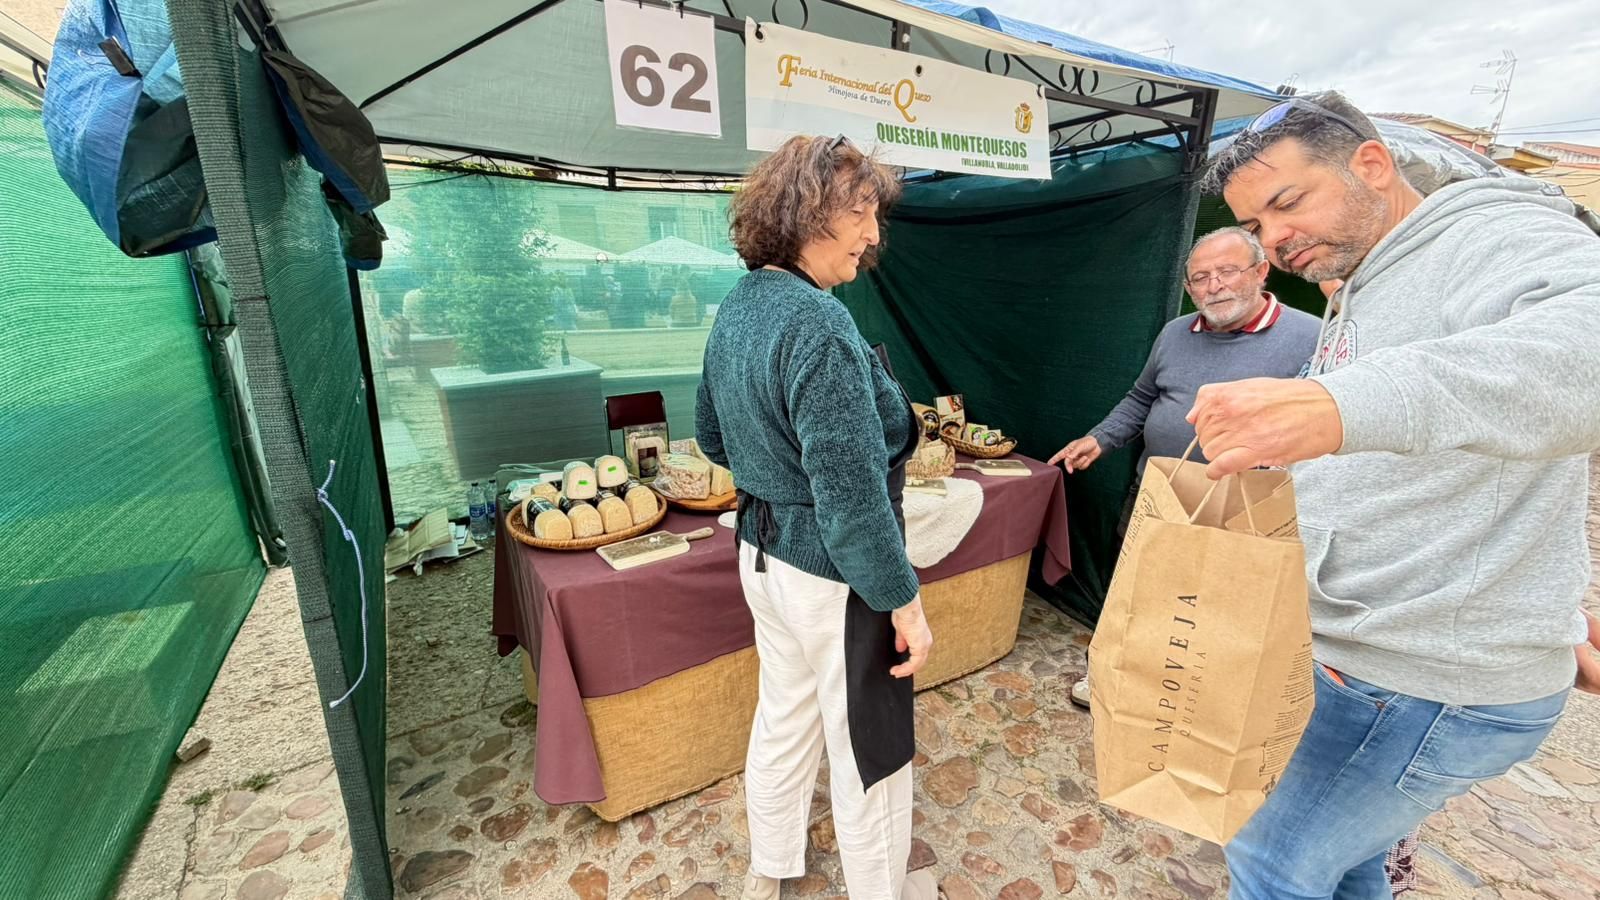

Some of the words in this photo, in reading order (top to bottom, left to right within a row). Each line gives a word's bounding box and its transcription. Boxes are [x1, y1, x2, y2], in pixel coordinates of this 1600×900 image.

[620, 44, 712, 114] 62
[777, 54, 818, 87] Feria
[819, 69, 879, 94] Internacional
[878, 82, 896, 96] del
[894, 79, 932, 123] Queso
[828, 85, 859, 100] Hinojosa
[860, 92, 868, 102] de
[869, 96, 892, 106] Duero
[876, 122, 939, 149] QUESERÍA
[941, 132, 1028, 158] MONTEQUESOS
[1147, 593, 1198, 772] CAMPOVEJA
[1179, 651, 1207, 738] QUESERIA
